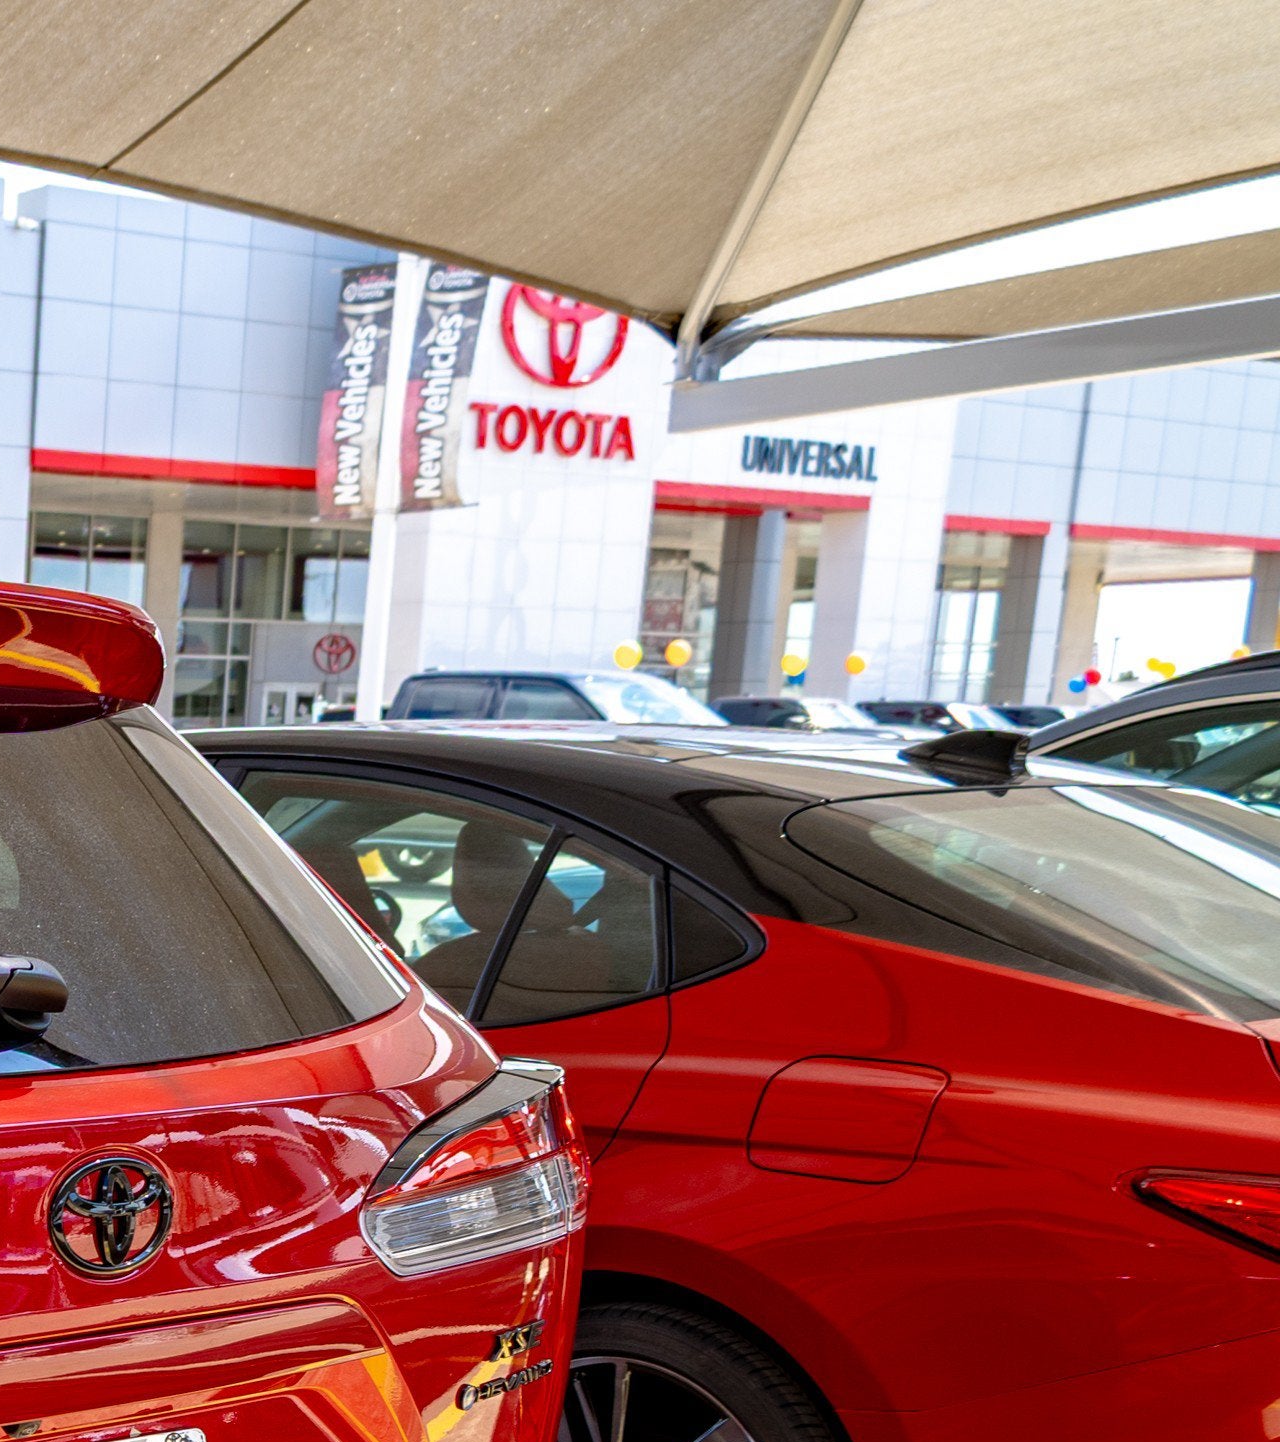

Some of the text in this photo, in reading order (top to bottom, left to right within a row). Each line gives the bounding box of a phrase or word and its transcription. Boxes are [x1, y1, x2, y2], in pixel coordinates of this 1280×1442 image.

[334, 323, 378, 441] Vehicles
[414, 312, 464, 498] New Vehicles
[469, 402, 635, 461] TOYOTA
[742, 435, 878, 482] UNIVERSAL
[333, 445, 361, 505] New
[490, 1319, 545, 1362] XSE
